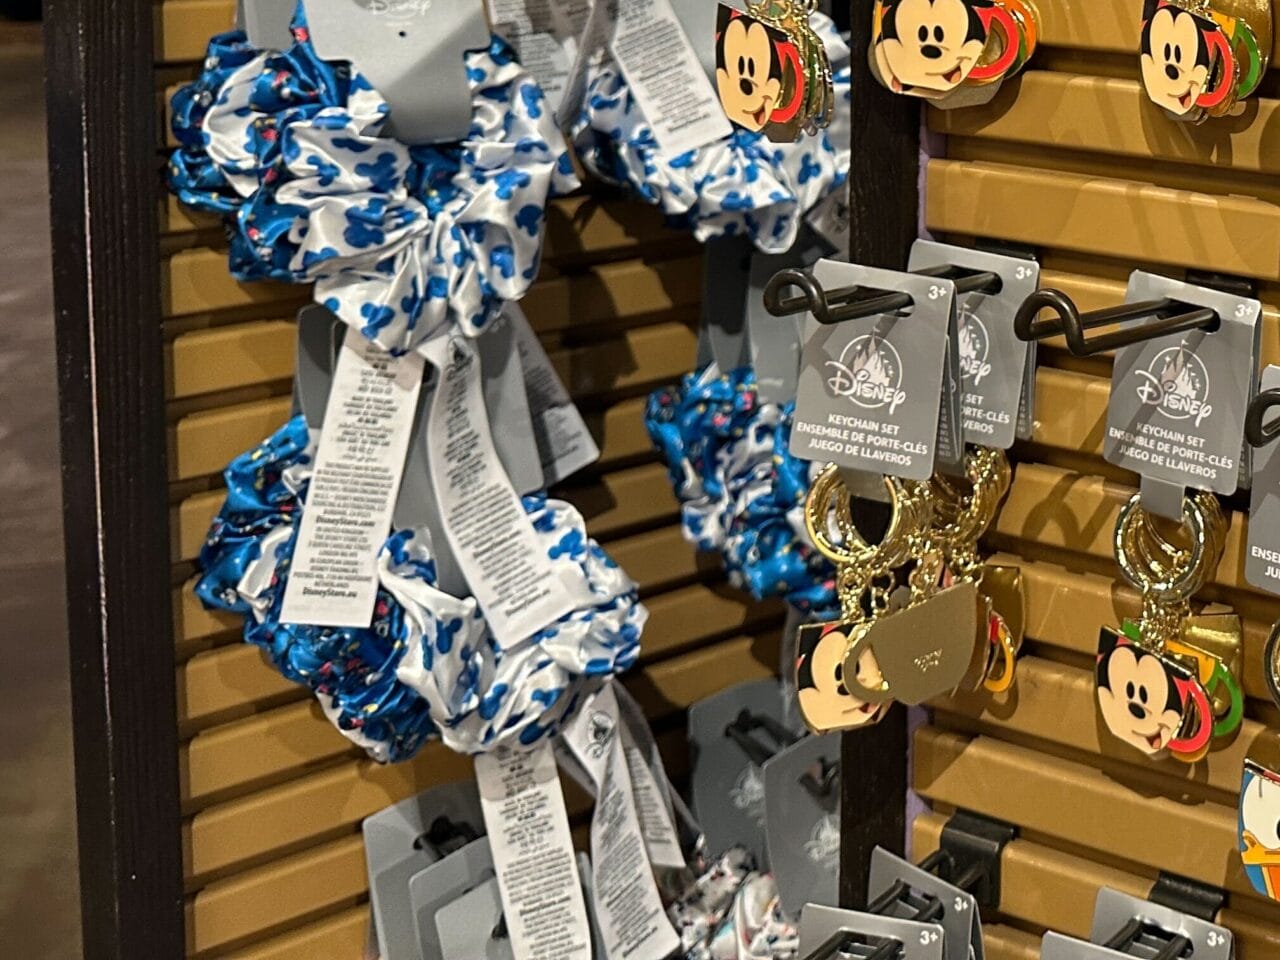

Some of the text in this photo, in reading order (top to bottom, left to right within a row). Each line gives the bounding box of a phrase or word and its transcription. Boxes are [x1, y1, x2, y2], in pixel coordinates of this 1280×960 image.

[1015, 266, 1033, 280] 3+
[928, 286, 947, 300] 3+
[1234, 304, 1253, 318] 3+
[825, 360, 905, 415] Disney
[966, 393, 984, 405] SET
[1134, 369, 1212, 428] Disney
[828, 413, 900, 436] KEYCHAIN SET
[1136, 422, 1205, 448] KEYCHAIN SET
[797, 421, 927, 454] ENSEMBLE DE PORTE-CLÉS
[1109, 427, 1233, 469] ENSEMBLE DE PORTE-CLÉS
[809, 438, 912, 466] JUEGO DE LLAVEROS
[1119, 445, 1216, 479] JUEGO DE LLAVEROS
[919, 929, 938, 944] 3+
[1206, 931, 1225, 946] 3+
